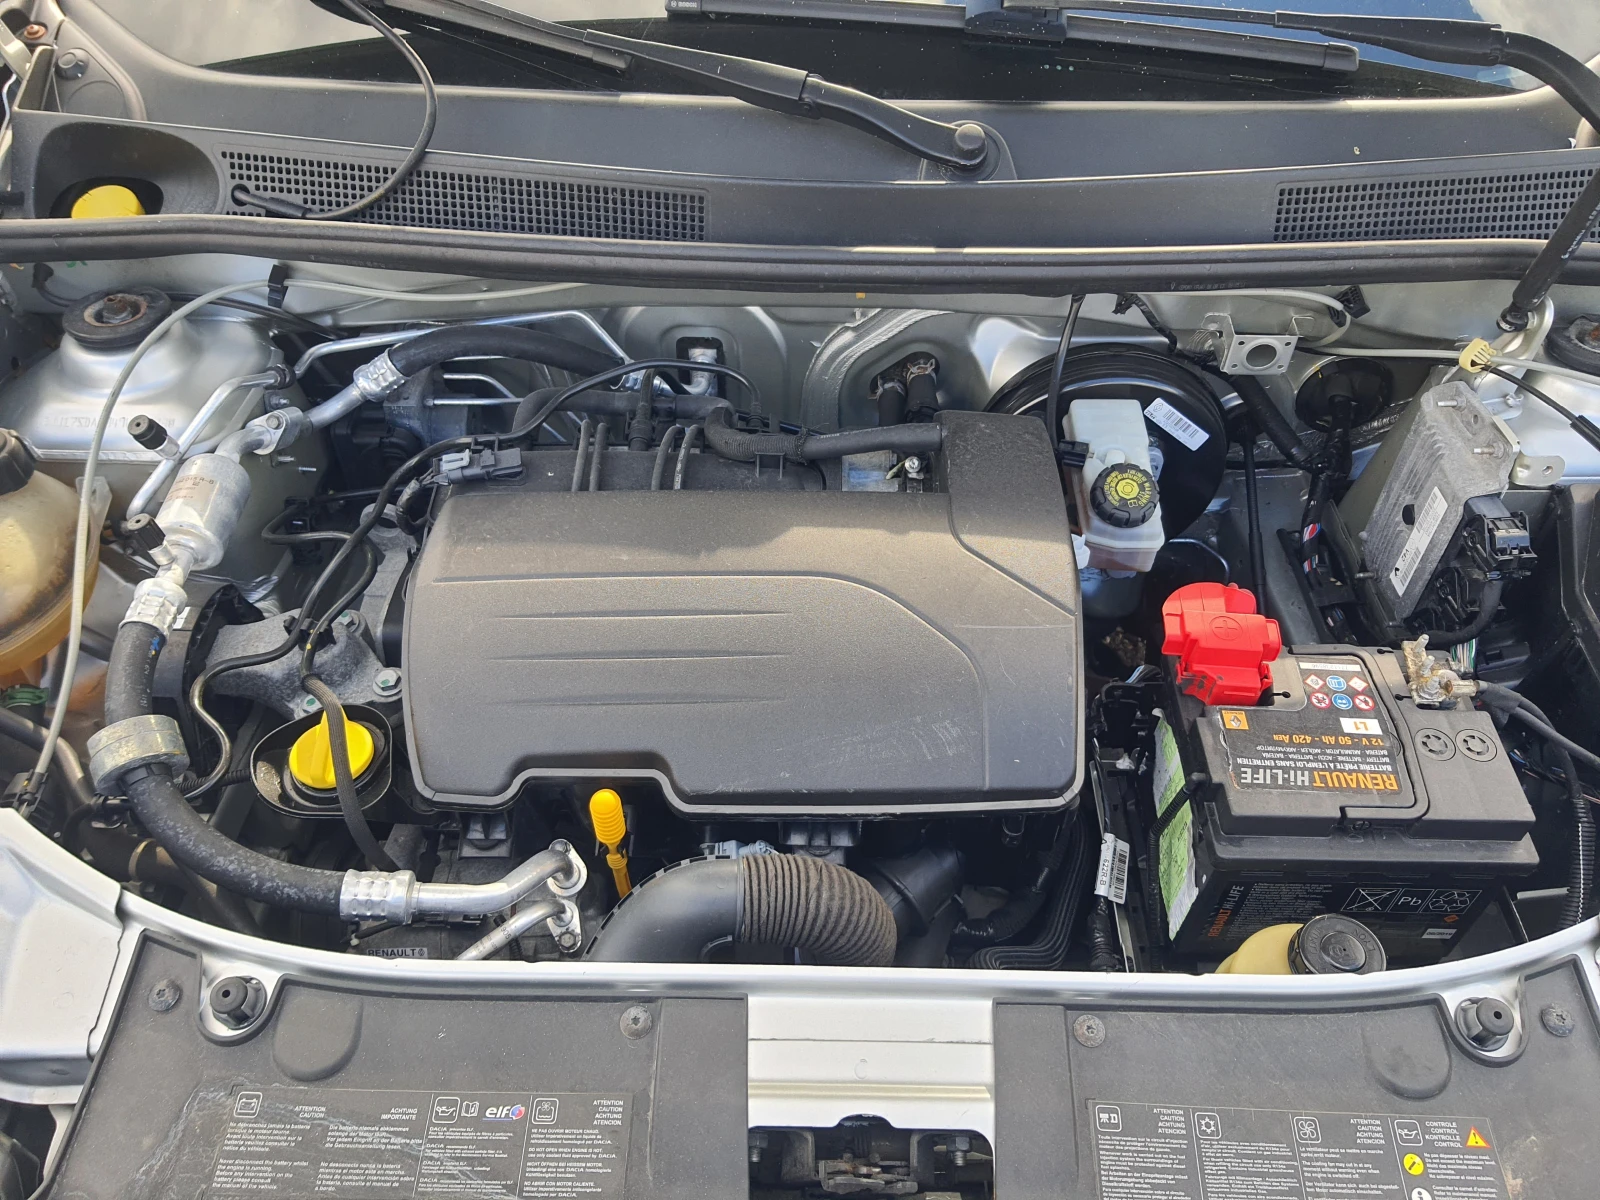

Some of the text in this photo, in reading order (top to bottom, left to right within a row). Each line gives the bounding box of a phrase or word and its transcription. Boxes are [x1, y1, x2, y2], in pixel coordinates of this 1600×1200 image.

[1354, 721, 1368, 732] L1
[1292, 734, 1311, 744] 420
[1322, 736, 1336, 744] Ah
[1338, 736, 1352, 745] 50
[1370, 737, 1384, 746] 12
[1237, 758, 1275, 766] ENTRETIEN
[1296, 761, 1328, 769] L'EMPLOI
[1241, 768, 1398, 790] RENAULT Hi-LIFE
[1398, 896, 1422, 906] Pb
[1208, 885, 1244, 937] RENAULT Hi-LIFE
[368, 948, 416, 957] RENAULT
[485, 1106, 511, 1118] elf
